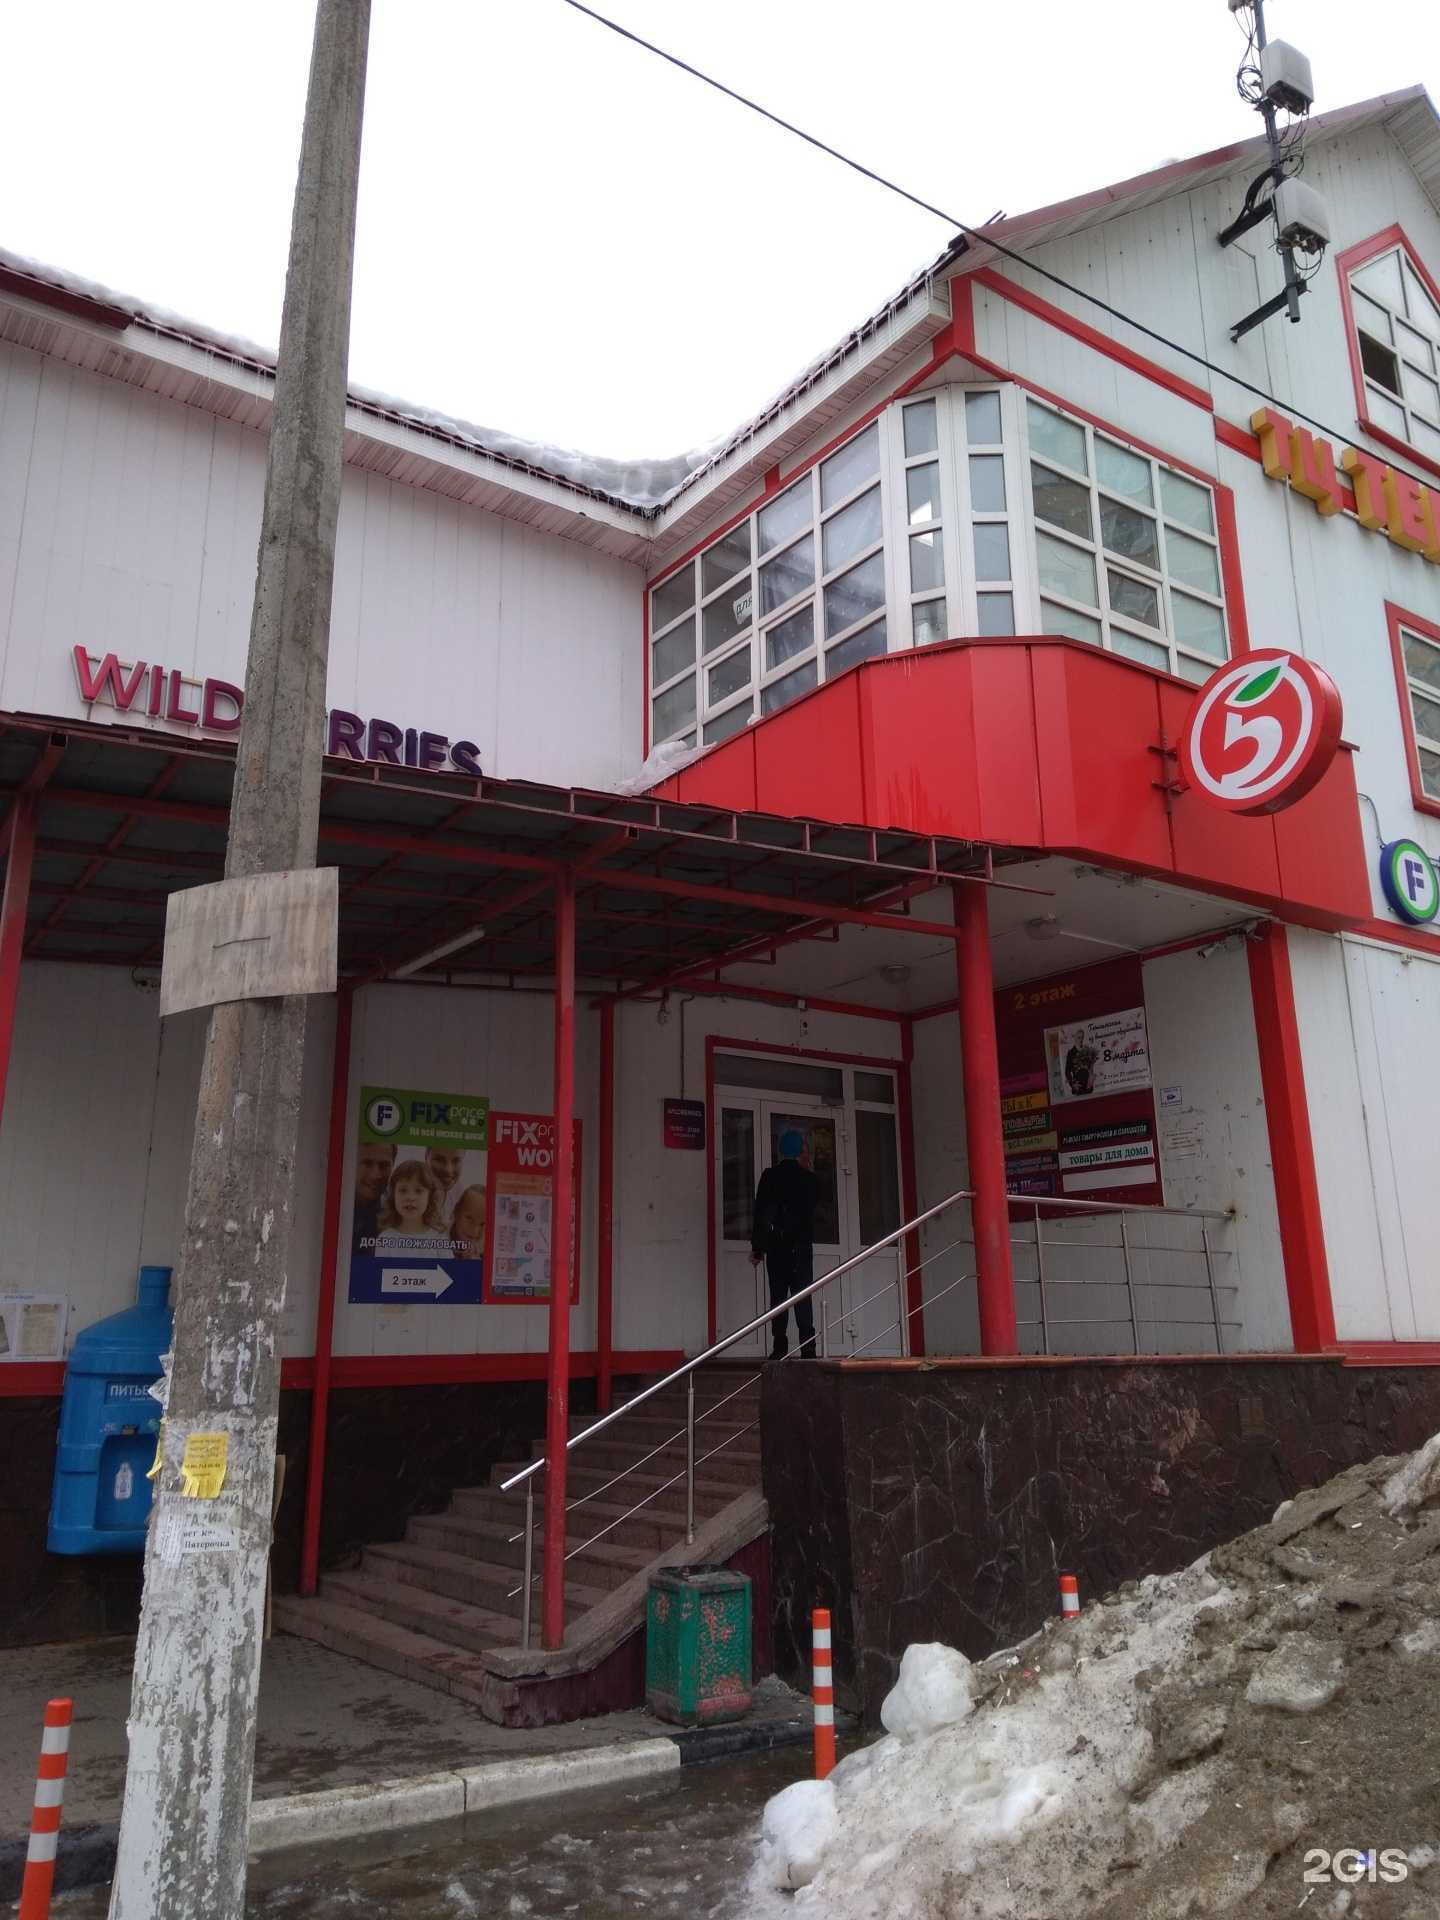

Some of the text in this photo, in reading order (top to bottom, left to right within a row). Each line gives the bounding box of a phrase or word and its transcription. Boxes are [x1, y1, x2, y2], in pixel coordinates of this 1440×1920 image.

[1013, 993, 1025, 1009] 2
[1103, 1049, 1112, 1062] 8
[1104, 1150, 1122, 1161] для
[1124, 1146, 1149, 1158] дома
[360, 1237, 396, 1249] ДОБРО
[392, 1275, 427, 1287] 2 этаж
